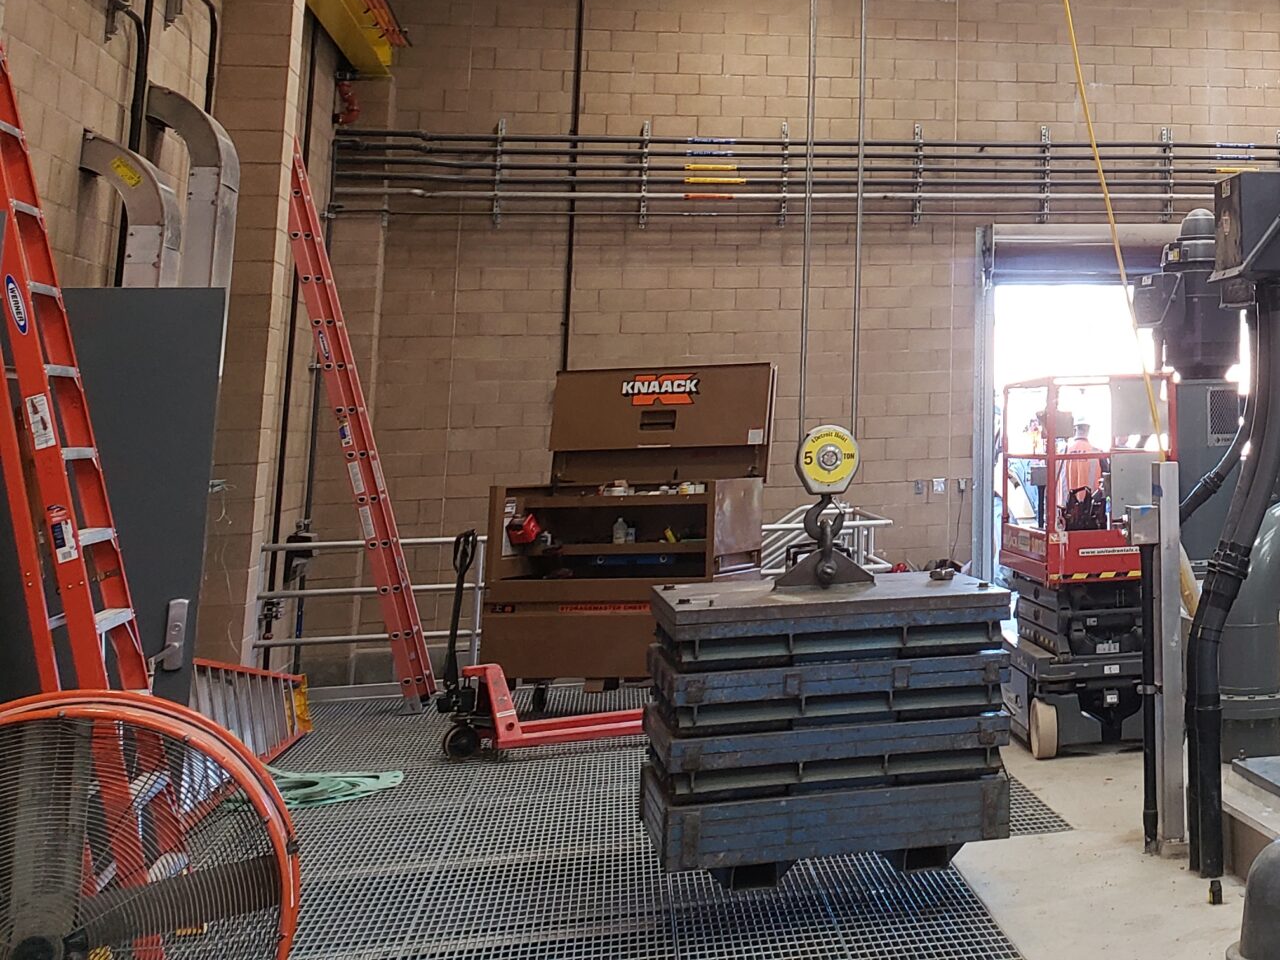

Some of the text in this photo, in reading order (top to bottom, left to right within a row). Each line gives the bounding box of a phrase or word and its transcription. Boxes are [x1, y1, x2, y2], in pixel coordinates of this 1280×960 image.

[9, 286, 24, 321] WERNER
[621, 378, 700, 396] KNAACK
[803, 450, 855, 466] 5 TON
